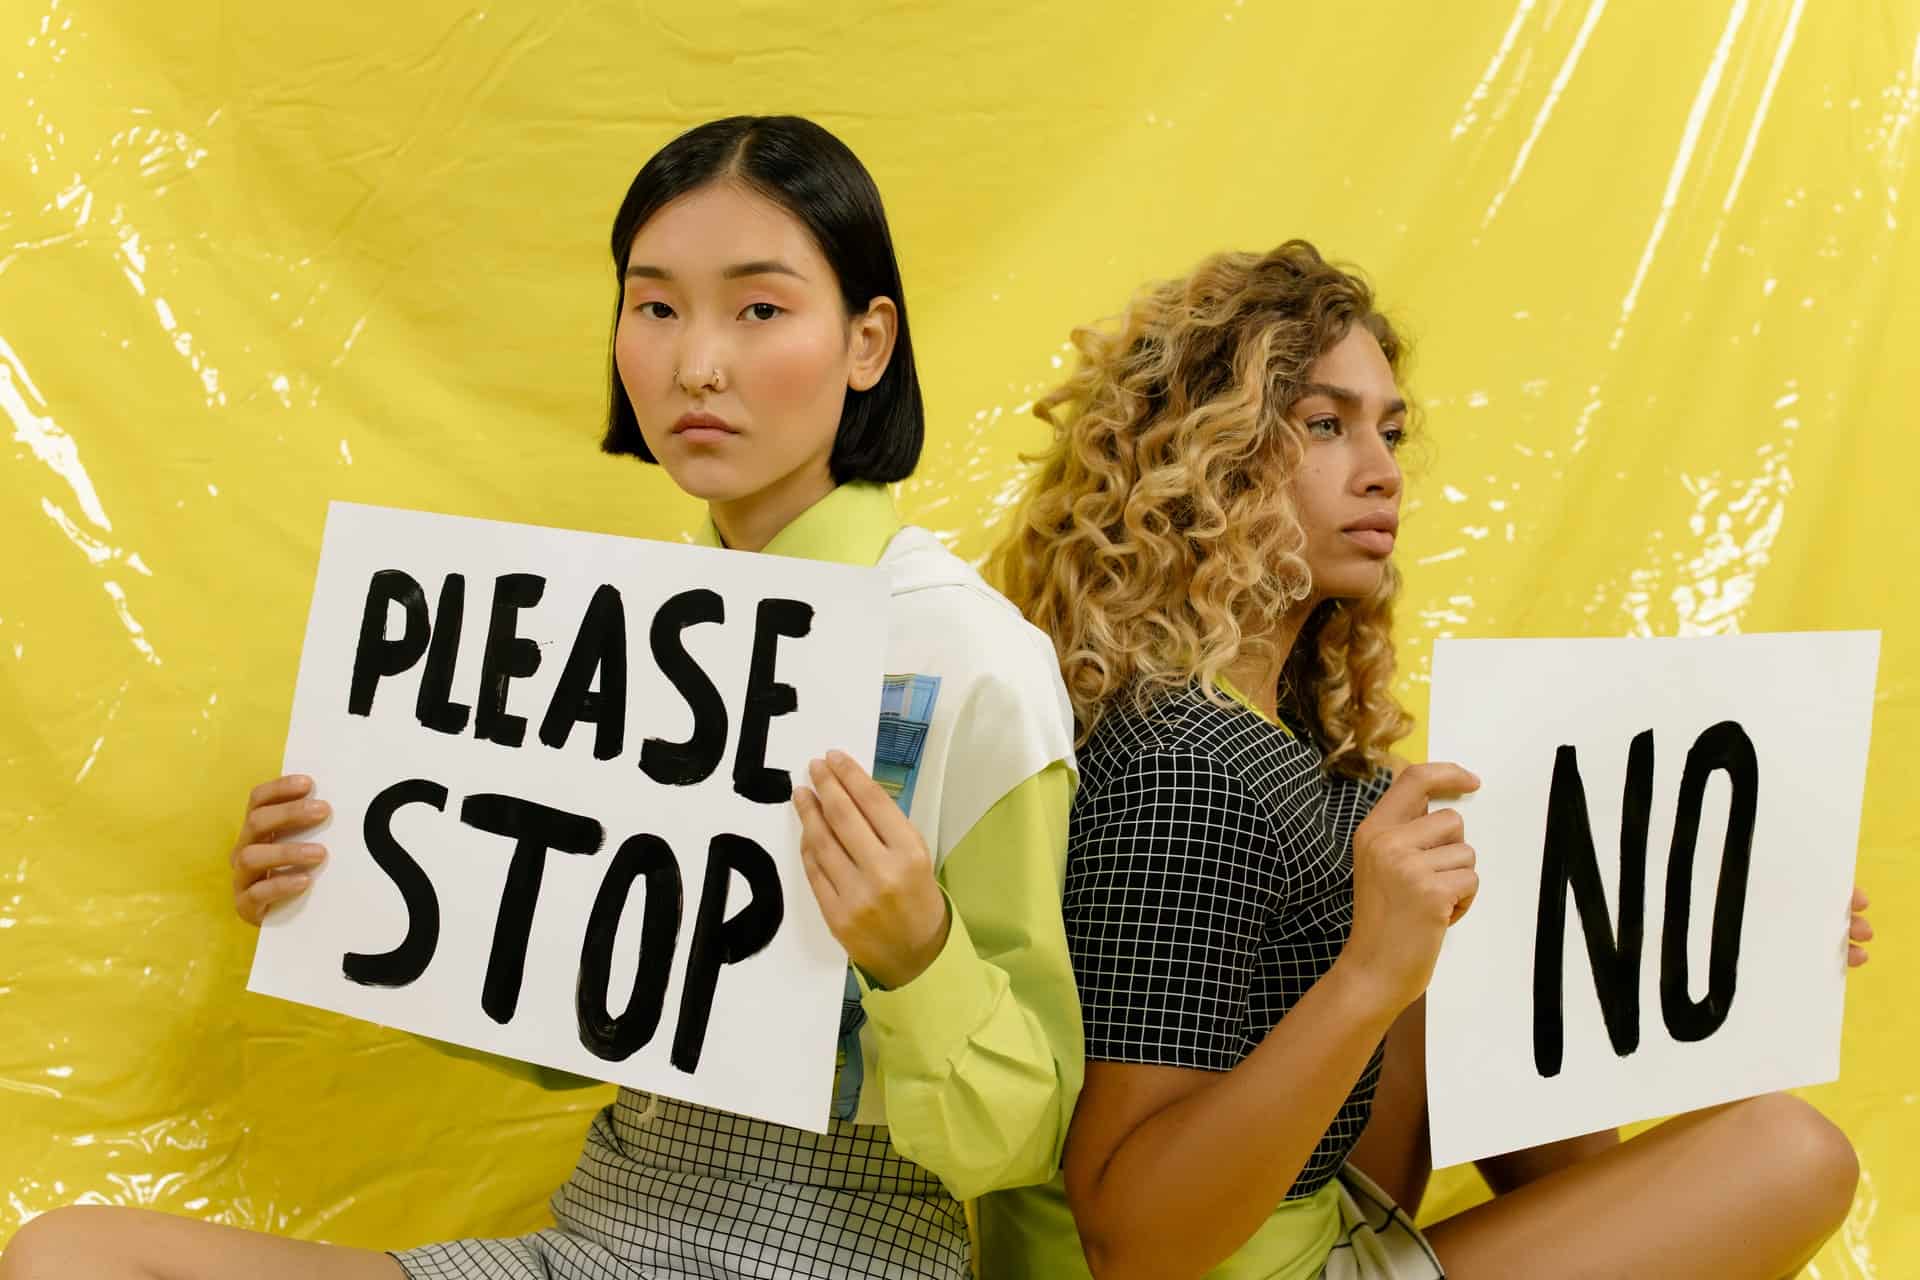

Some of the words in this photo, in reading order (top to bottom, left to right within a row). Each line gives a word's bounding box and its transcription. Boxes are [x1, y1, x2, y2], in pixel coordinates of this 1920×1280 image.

[348, 569, 815, 805] PLEASE
[342, 778, 785, 1075] STOP
[1533, 720, 1759, 1079] NO
